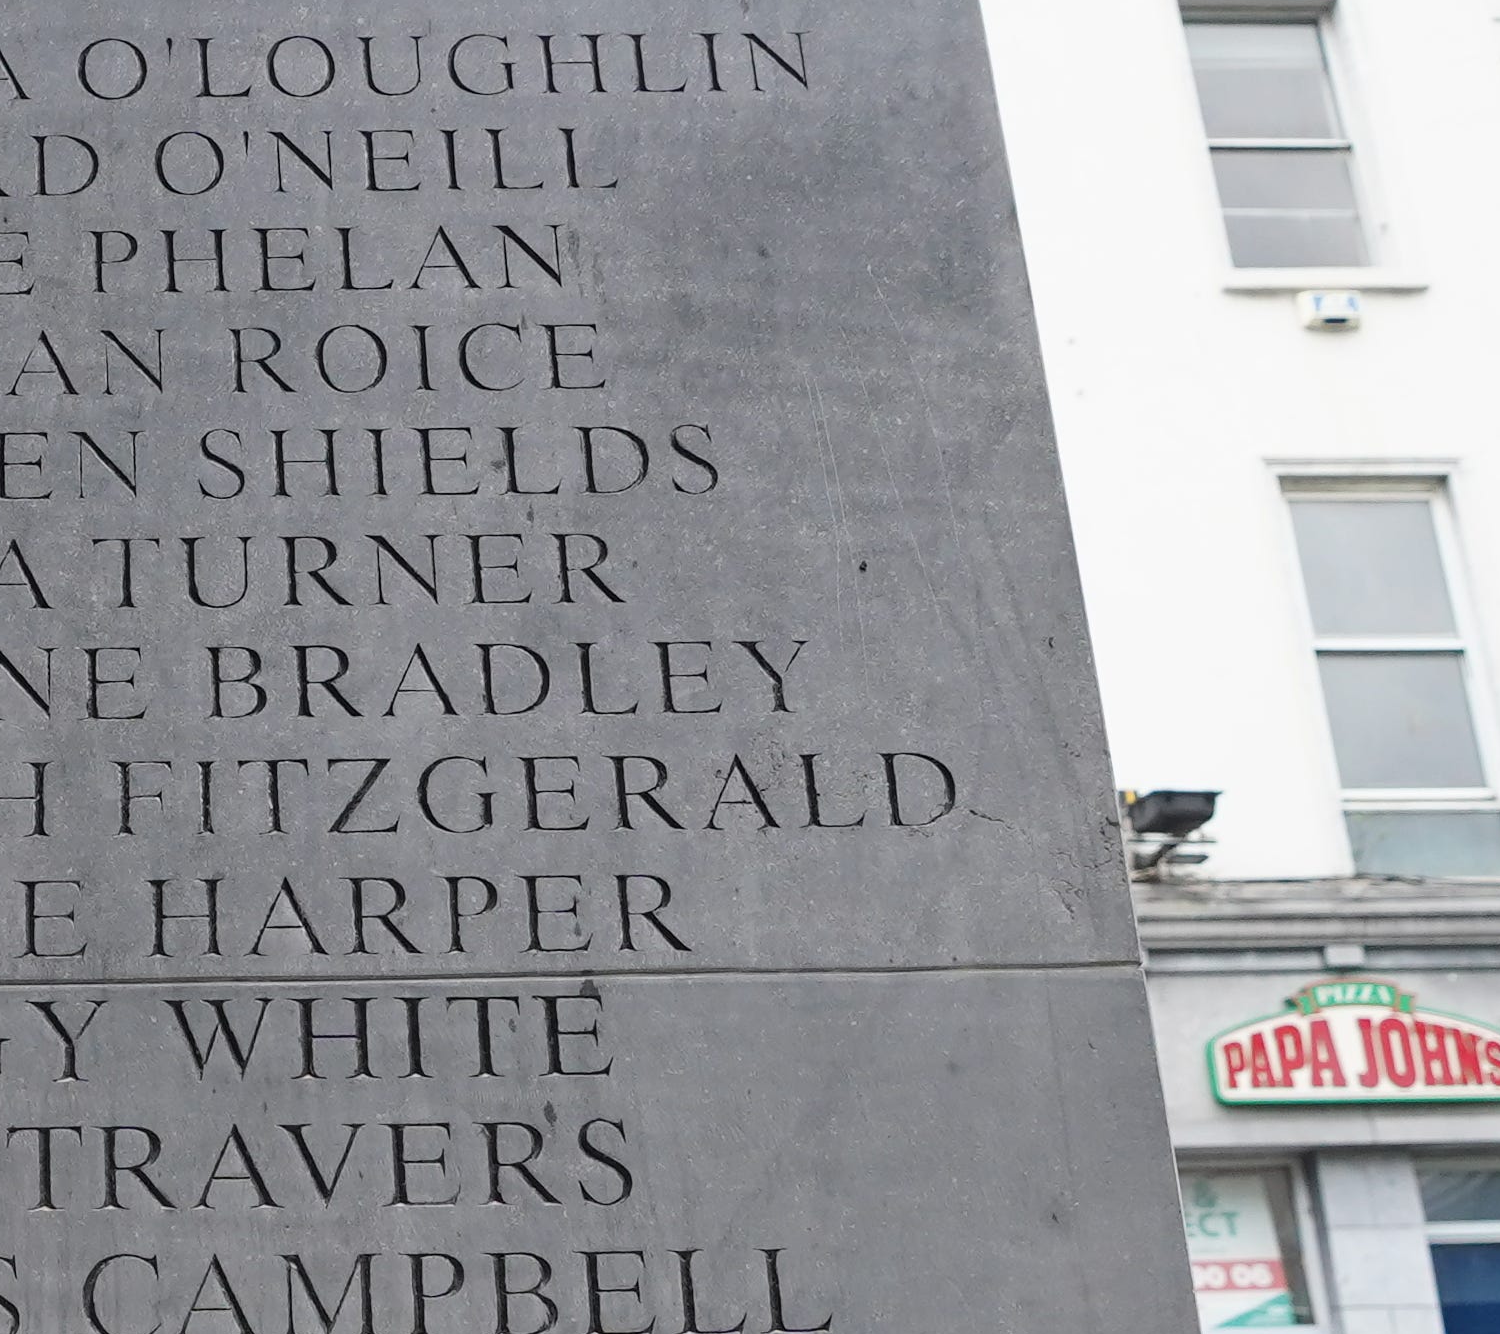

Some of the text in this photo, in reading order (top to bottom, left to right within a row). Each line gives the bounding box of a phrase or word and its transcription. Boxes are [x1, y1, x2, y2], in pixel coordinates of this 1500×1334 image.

[77, 31, 814, 100] O'LOUGHLIN
[154, 128, 619, 197] O'NEILL
[89, 225, 570, 295] PHELAN
[230, 322, 608, 393] ROICE
[199, 423, 722, 500] SHIELDS
[91, 532, 628, 608] TURNER
[206, 639, 811, 721] BRADLEY
[112, 752, 961, 840] FITZGERALD
[147, 873, 694, 958] HARPER
[1315, 984, 1393, 1004] PIZZA
[164, 994, 614, 1081] WHITE
[1223, 1019, 1347, 1088] PAPA
[7, 1118, 637, 1212] TRAVERS
